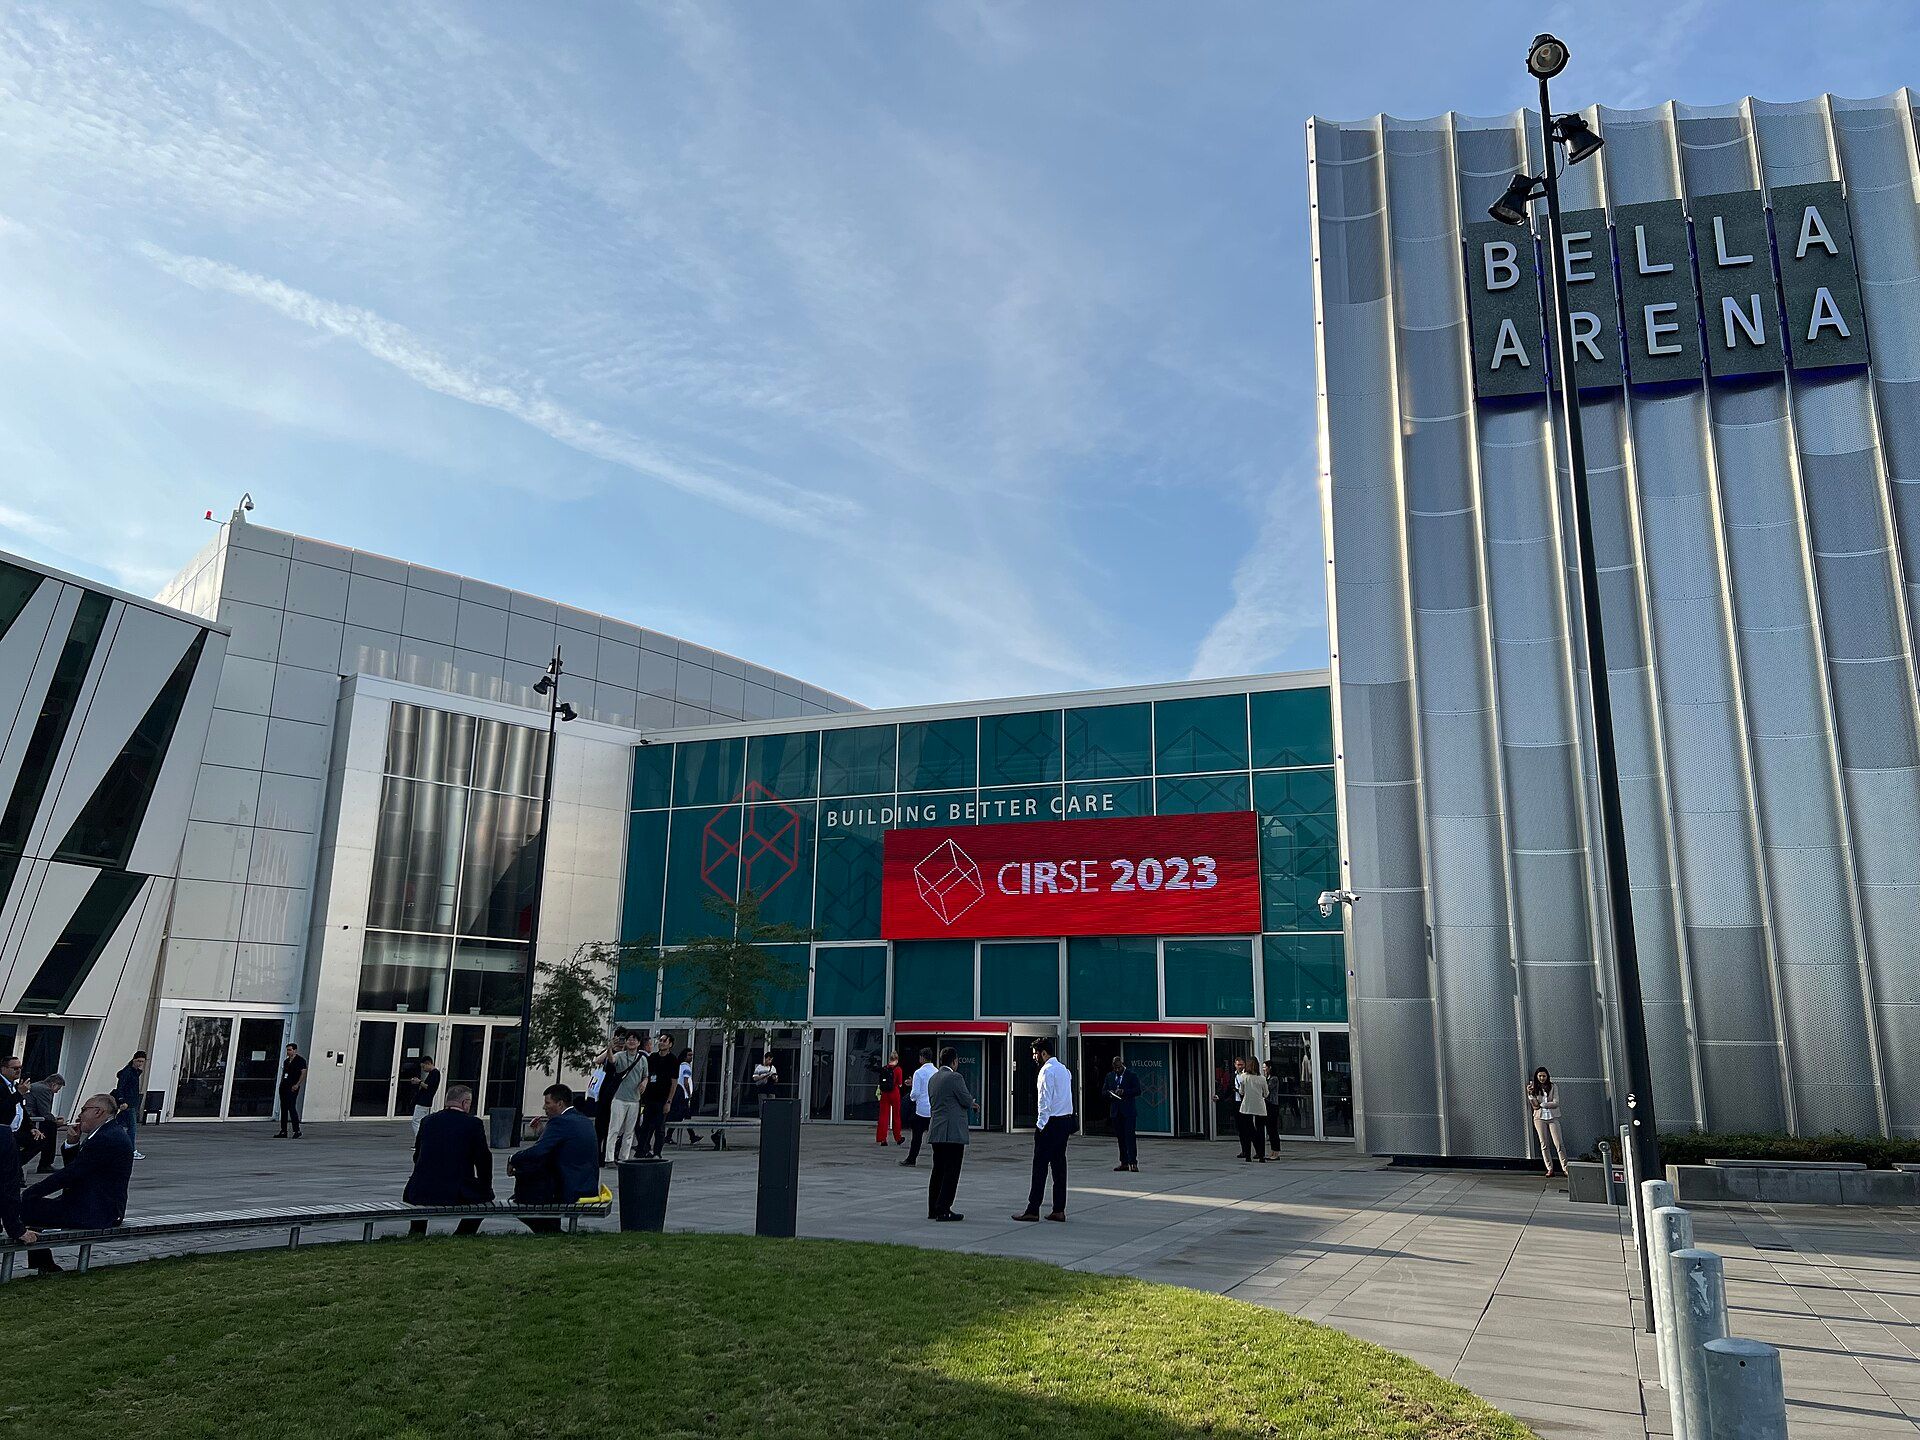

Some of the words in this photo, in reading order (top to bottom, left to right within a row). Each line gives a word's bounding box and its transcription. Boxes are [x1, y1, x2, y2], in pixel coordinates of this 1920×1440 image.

[1483, 205, 1839, 291] BELLA
[1490, 286, 1851, 370] ARENA
[827, 804, 937, 827] BUILDING
[949, 798, 1038, 820] BETTER
[1050, 793, 1114, 814] CARE
[997, 859, 1099, 895] CIRSE
[1110, 855, 1218, 892] 2023
[1130, 1059, 1163, 1068] WELCOME
